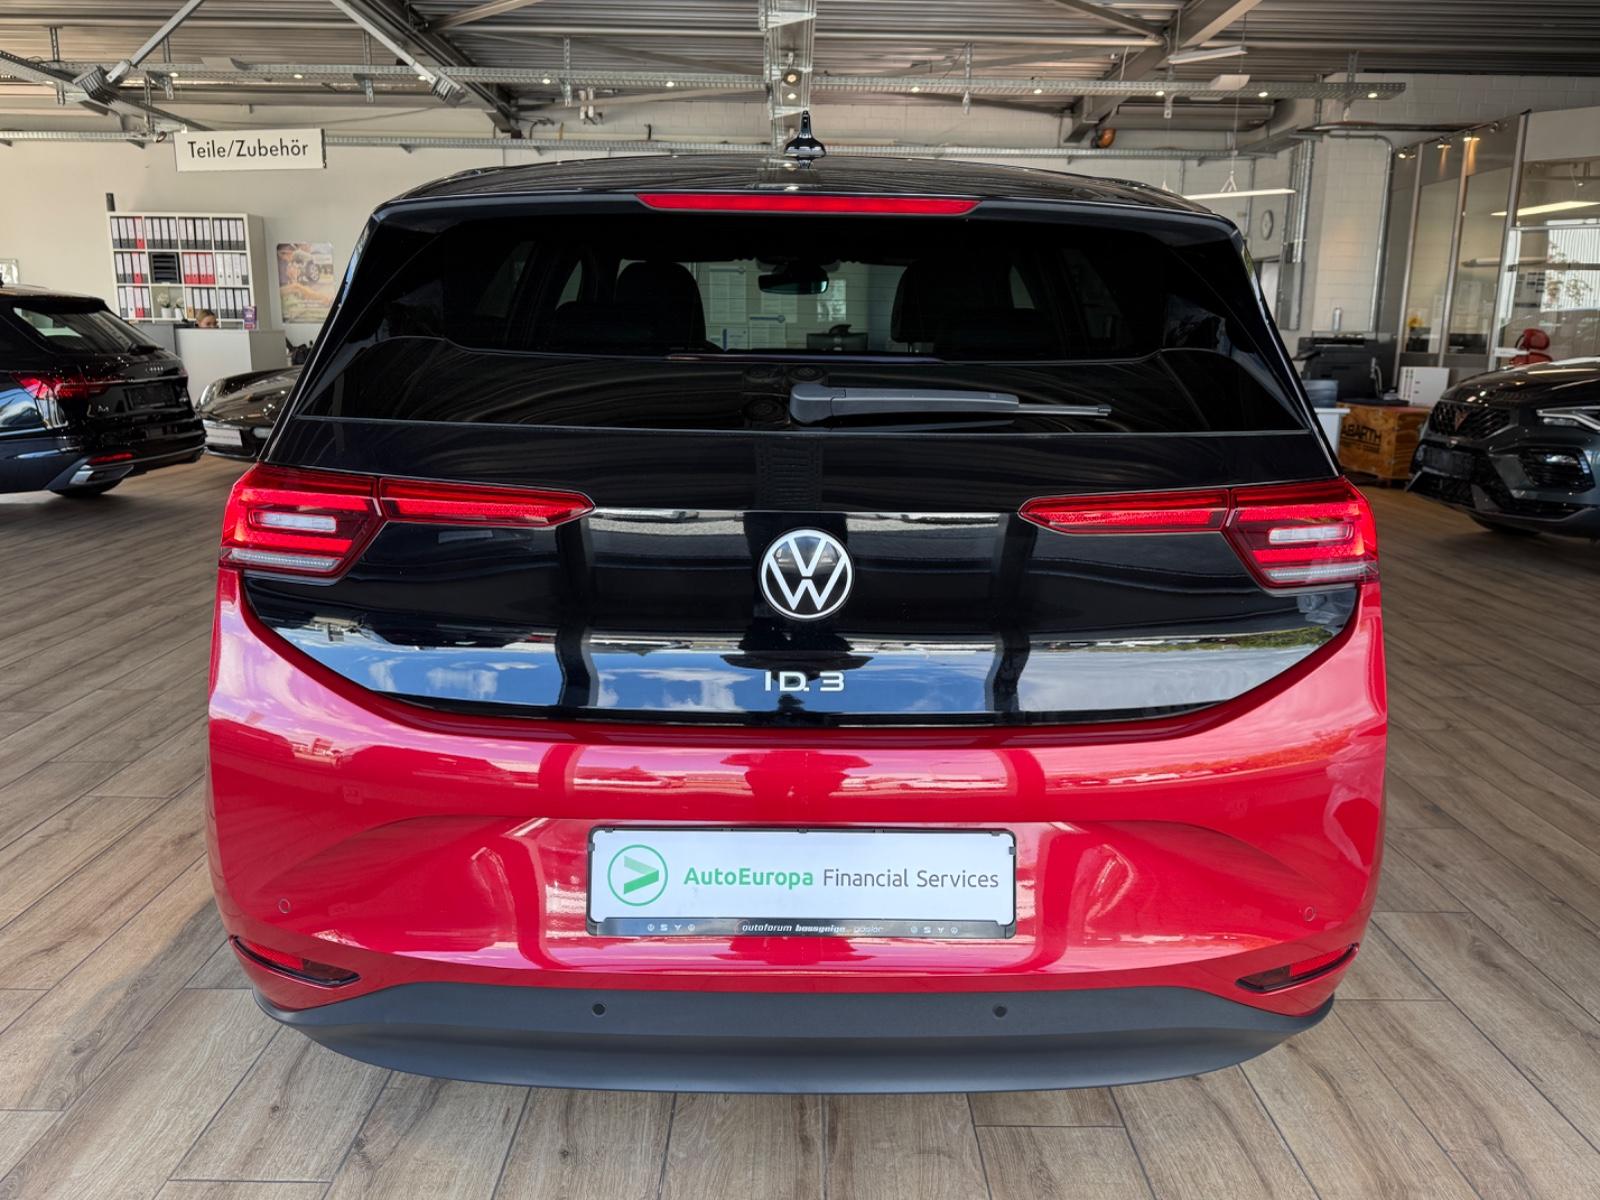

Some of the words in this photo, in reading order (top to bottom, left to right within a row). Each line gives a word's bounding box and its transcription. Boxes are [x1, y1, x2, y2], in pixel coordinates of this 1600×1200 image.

[187, 138, 308, 158] Teile/Zubehör
[683, 867, 814, 890] AutoEuropa
[823, 868, 909, 888] Financial
[916, 870, 999, 889] Services
